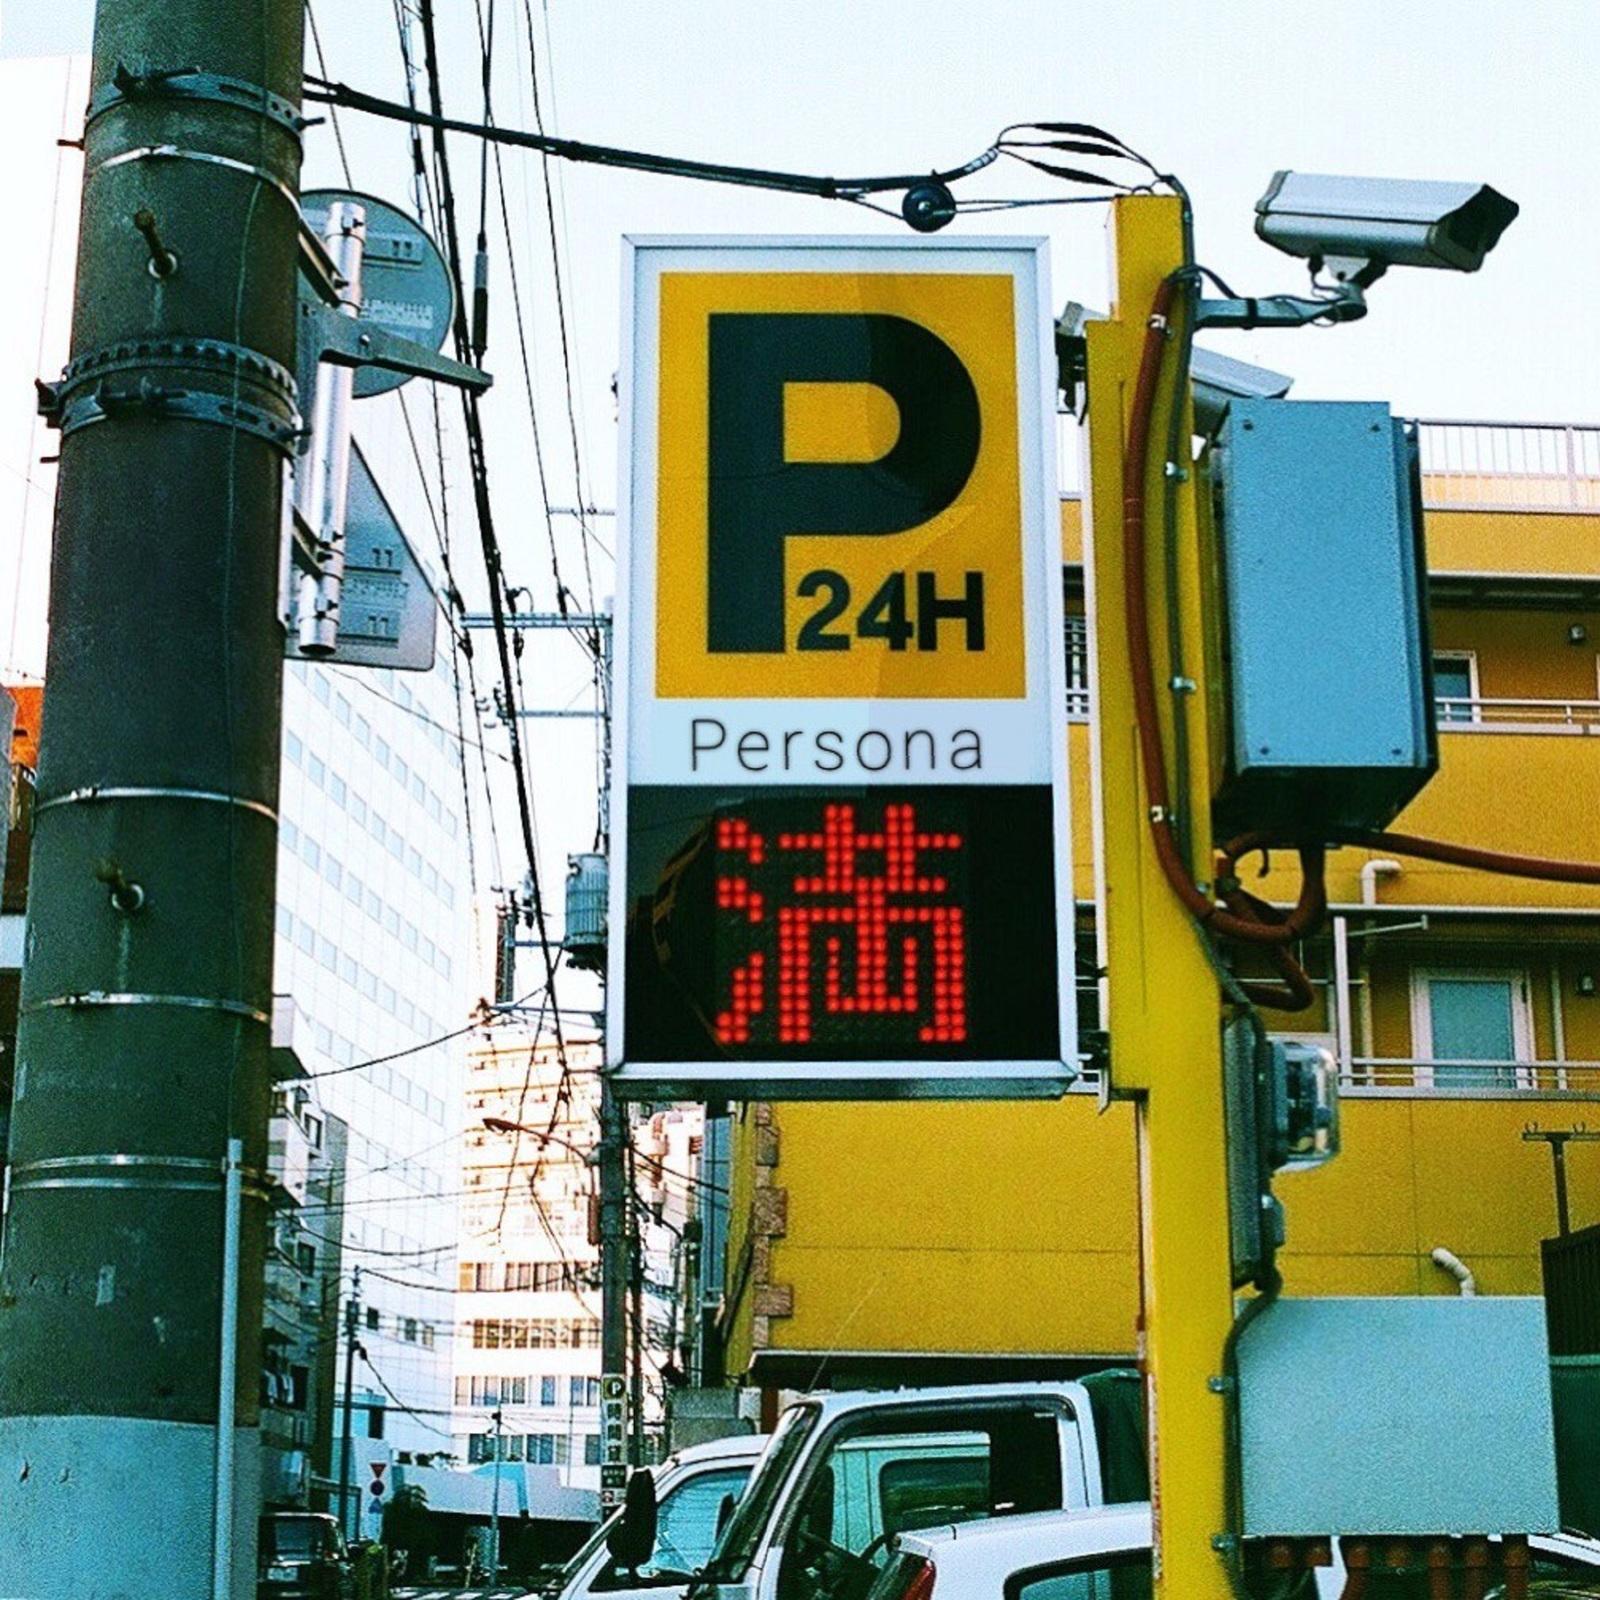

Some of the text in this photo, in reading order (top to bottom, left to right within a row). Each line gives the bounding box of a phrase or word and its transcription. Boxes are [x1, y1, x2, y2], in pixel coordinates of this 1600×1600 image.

[707, 313, 982, 654] P
[796, 570, 985, 652] 24H
[690, 718, 982, 772] Persona
[716, 803, 967, 1042] 満
